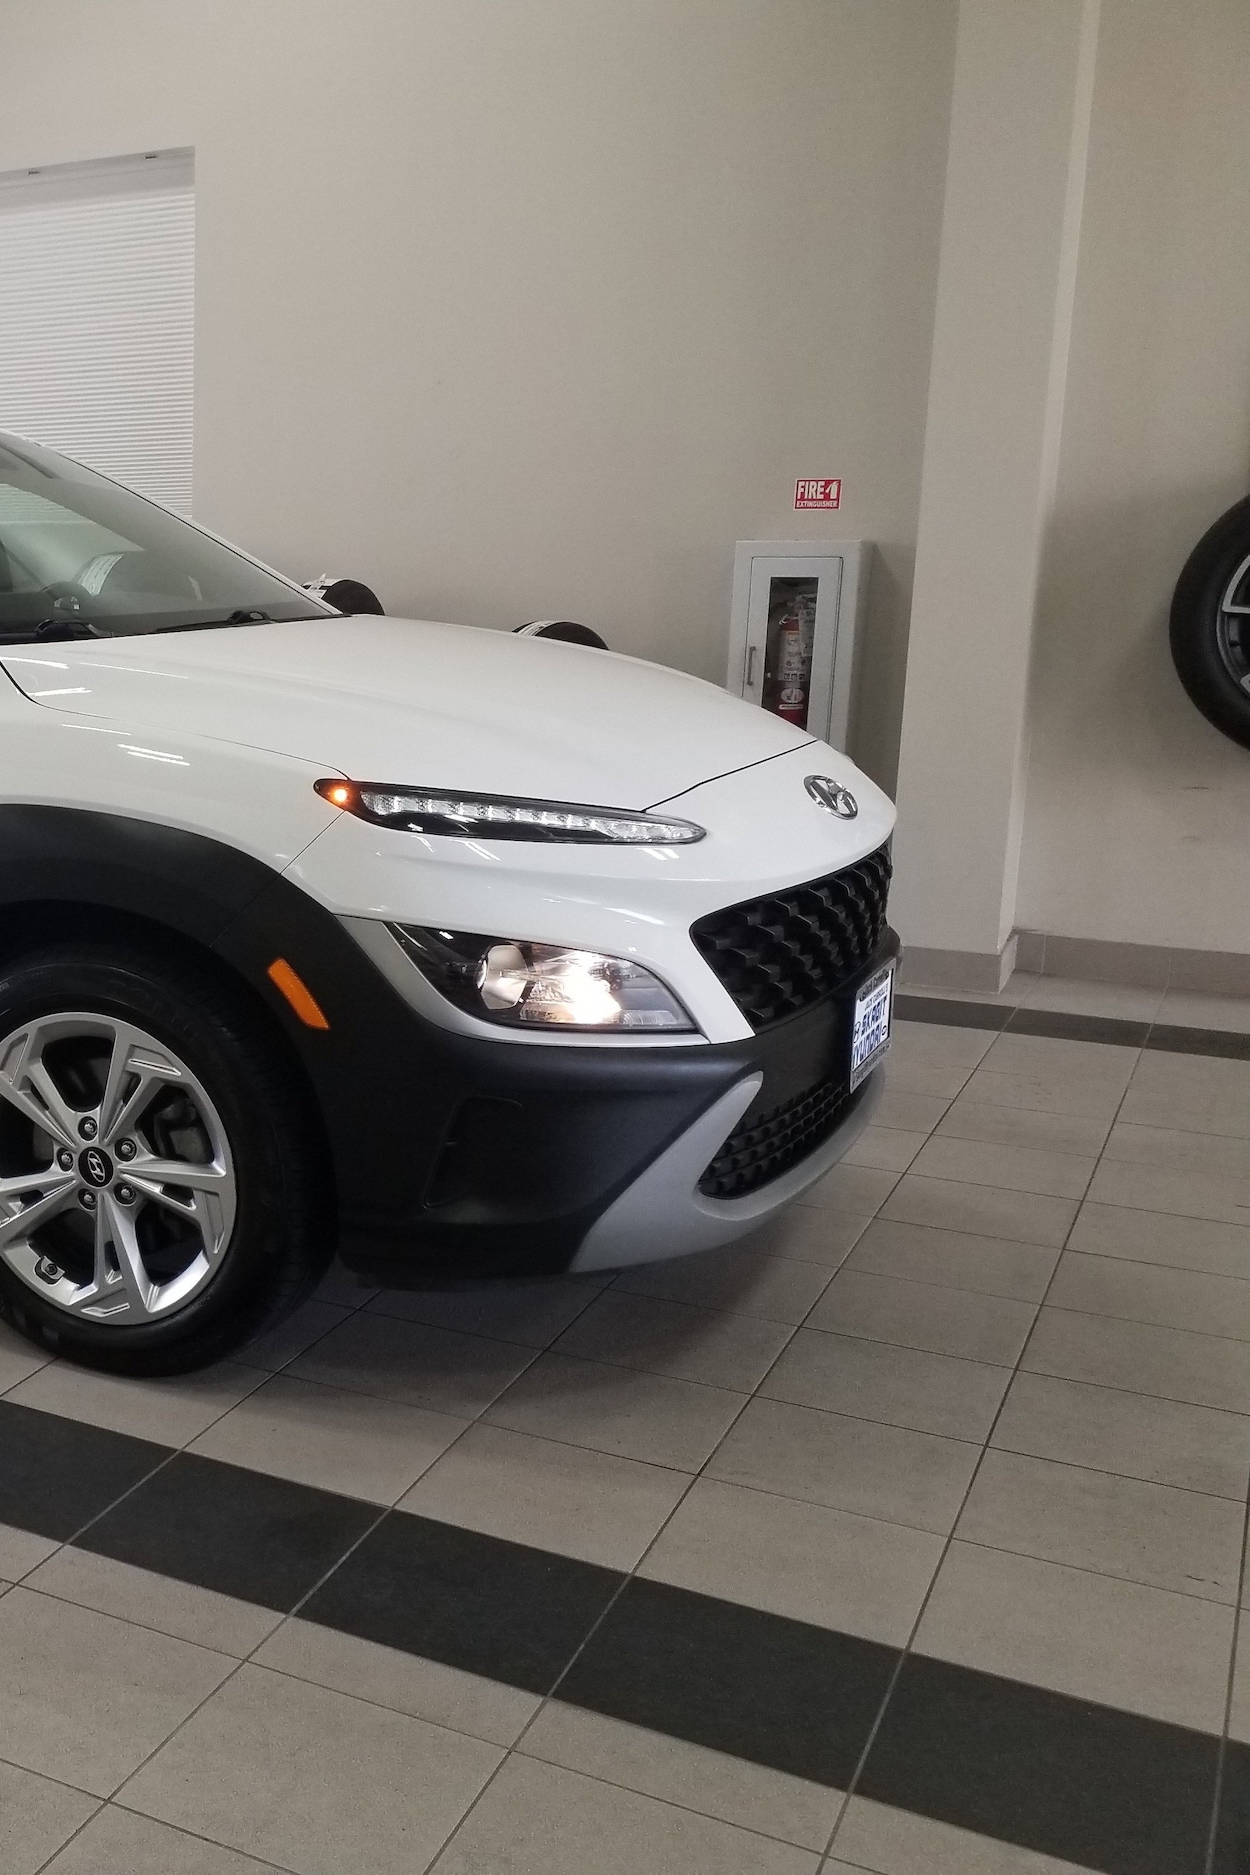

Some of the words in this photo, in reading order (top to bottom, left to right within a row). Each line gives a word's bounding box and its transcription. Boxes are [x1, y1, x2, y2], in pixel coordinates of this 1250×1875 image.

[797, 481, 825, 499] FIRE
[796, 500, 838, 508] EXTINGUISHER
[861, 994, 888, 1037] SKAGIT
